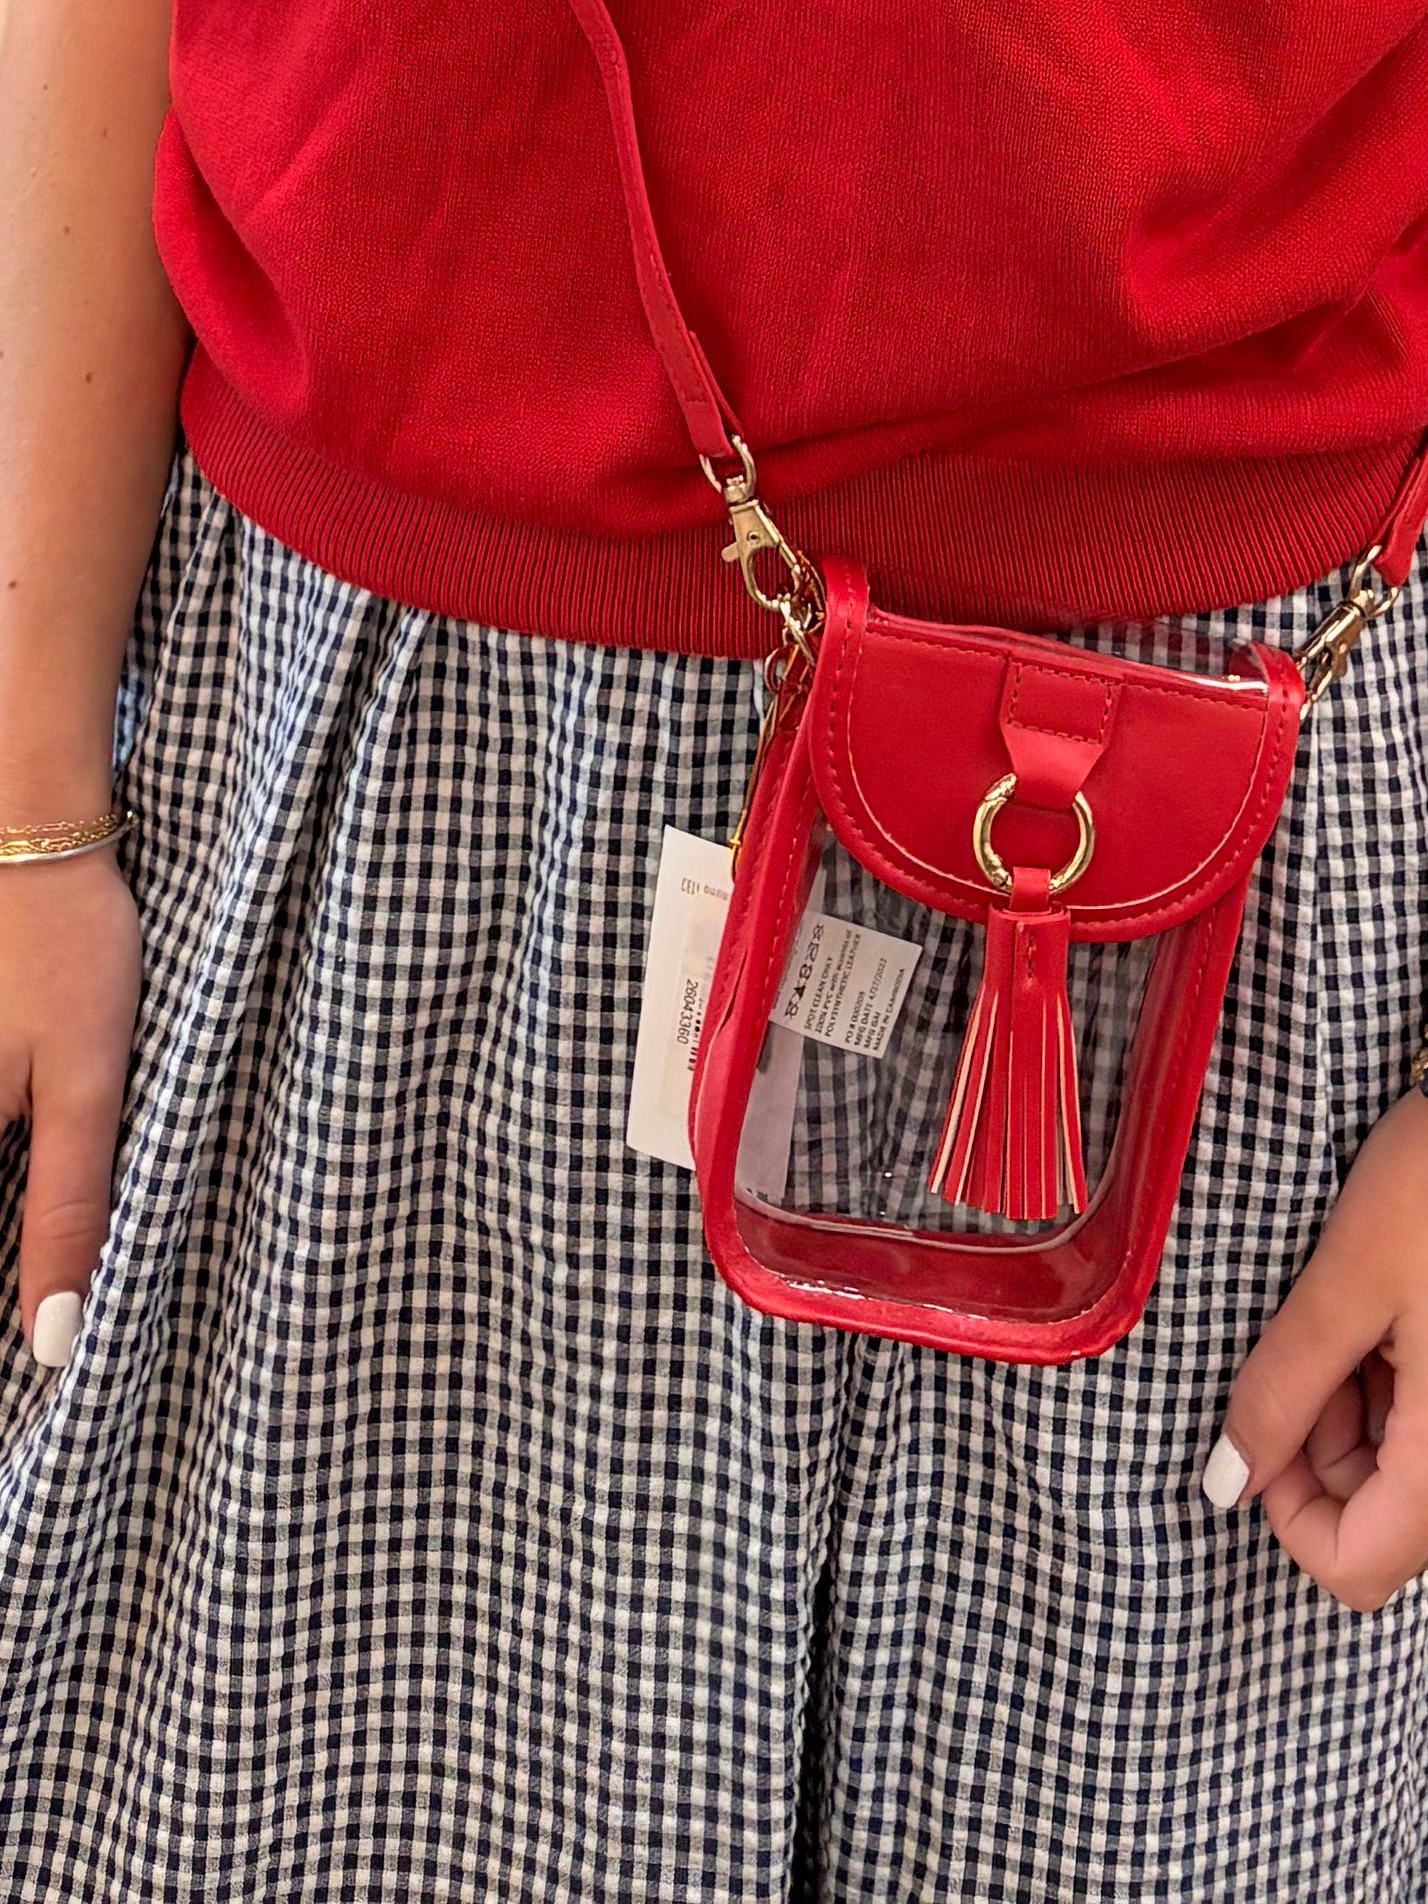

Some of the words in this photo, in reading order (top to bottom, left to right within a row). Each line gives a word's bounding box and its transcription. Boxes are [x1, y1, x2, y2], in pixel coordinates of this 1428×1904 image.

[676, 978, 699, 1045] 26043360
[805, 1008, 817, 1030] SPOT
[813, 980, 826, 1008] CLEAN
[821, 955, 833, 979] ONLY
[823, 992, 833, 1009] PVC
[861, 1002, 873, 1025] DATE
[874, 1025, 886, 1051] MADE
[887, 967, 904, 1013] CAMBODIA
